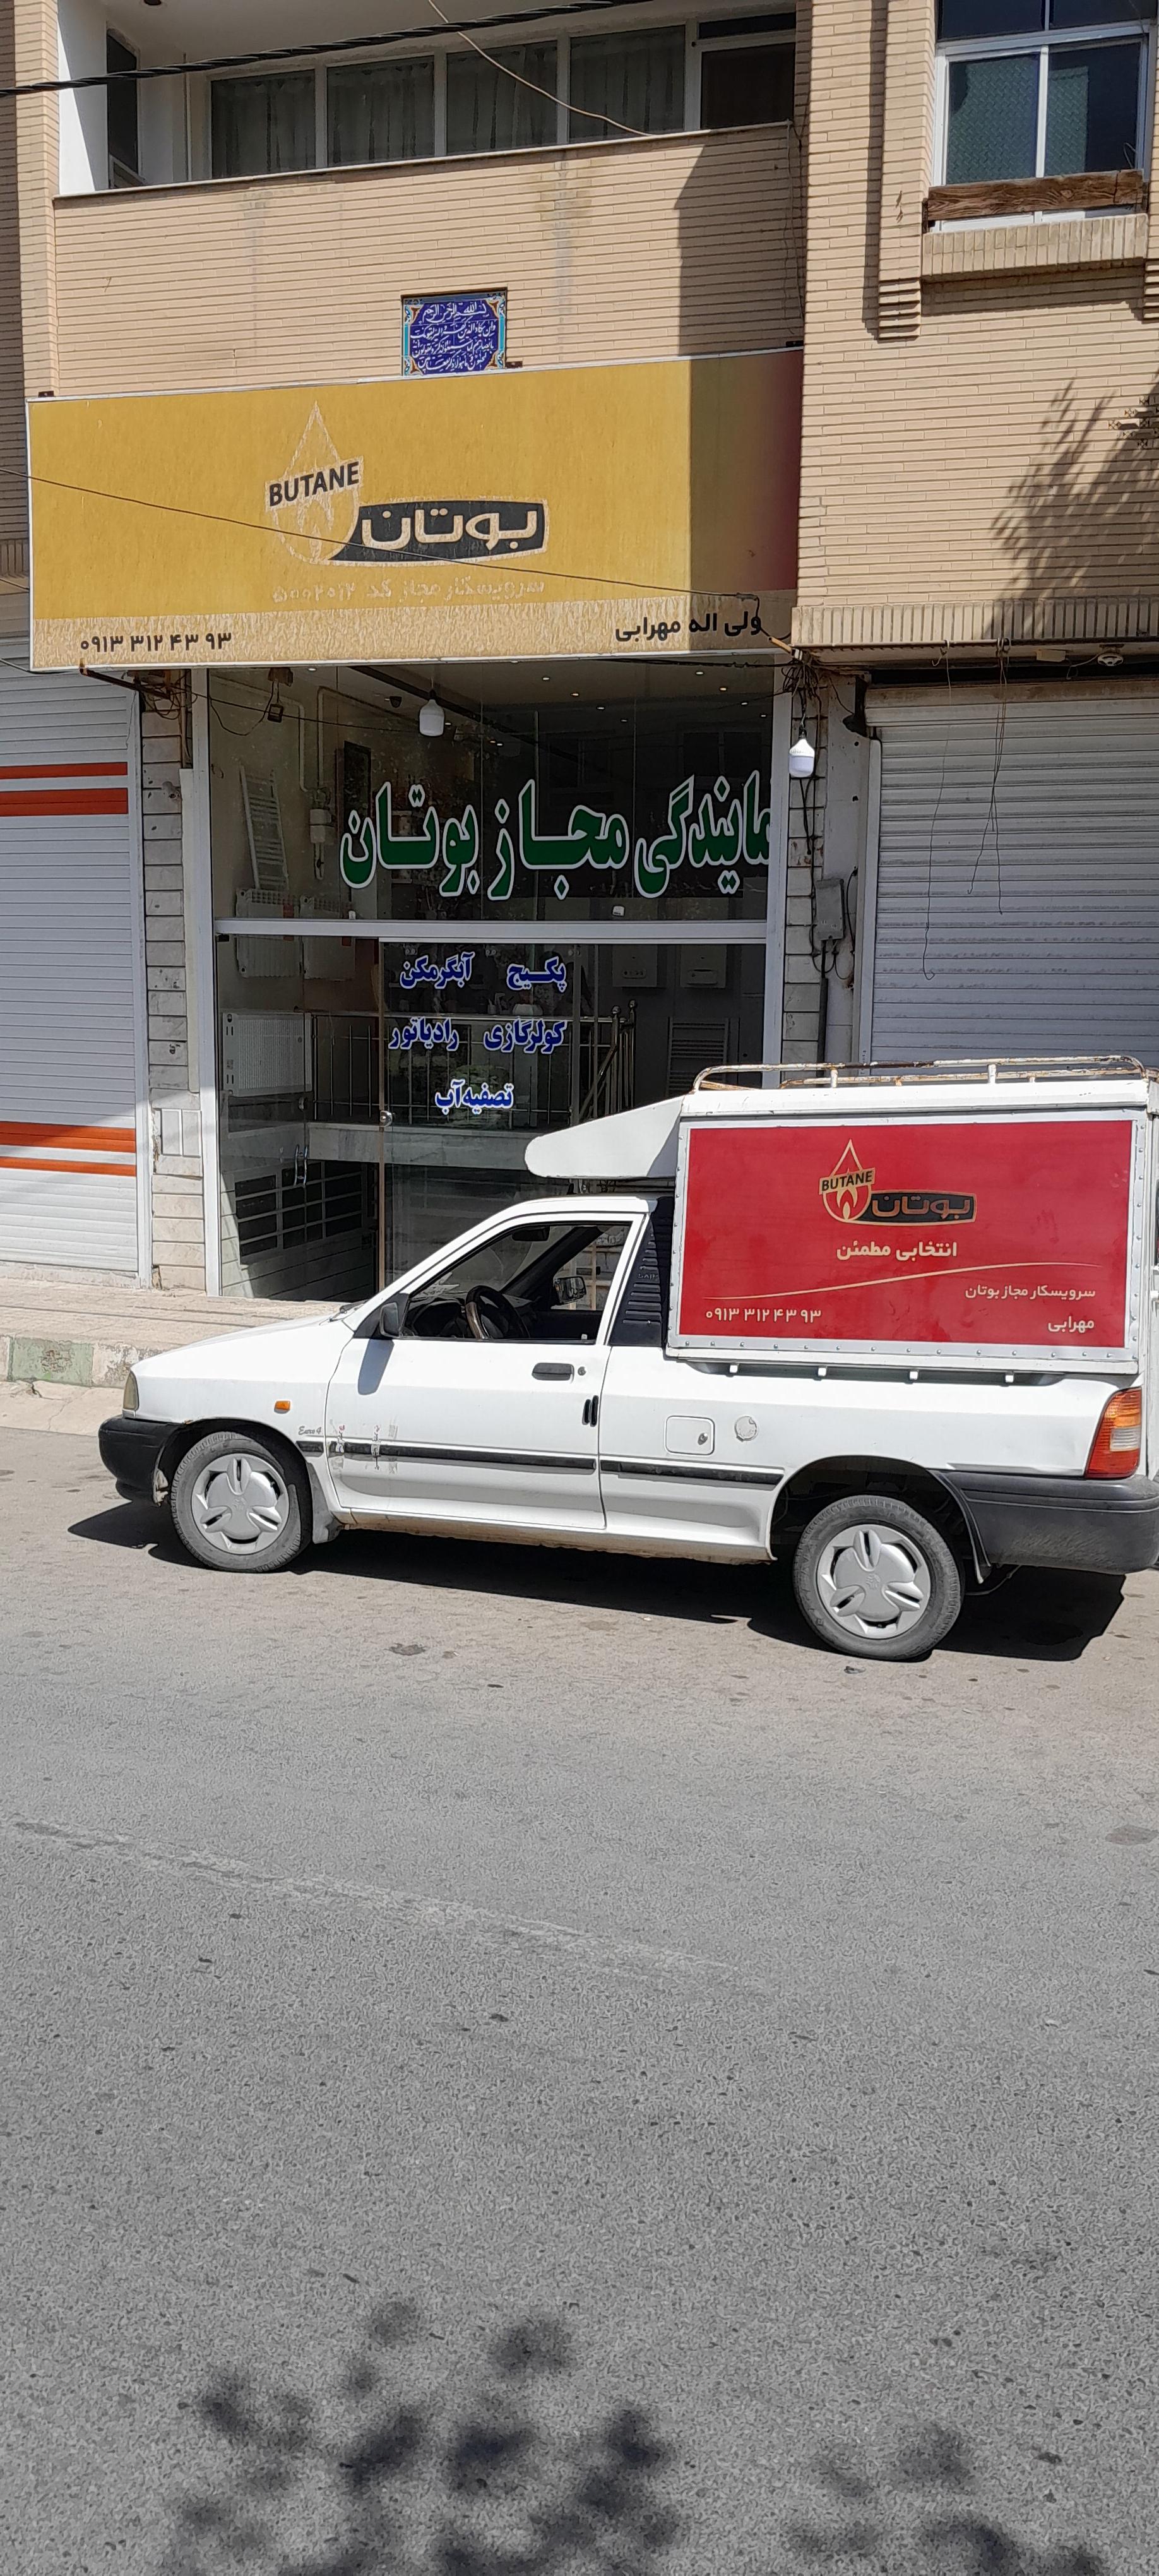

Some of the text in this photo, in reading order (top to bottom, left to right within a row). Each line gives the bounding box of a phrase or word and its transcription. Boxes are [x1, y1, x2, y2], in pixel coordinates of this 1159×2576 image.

[269, 461, 359, 506] BUTANE
[362, 508, 537, 551] بوتان
[615, 611, 761, 642] ولی اله مهرابی
[80, 632, 232, 652] ۰۹۱۳ ۳۱۲ ۴۳ ۹۳
[340, 770, 770, 900] مایندگی مجاز بوتان
[506, 956, 567, 993] پکیج
[388, 1017, 459, 1051] رادیاتور
[821, 1171, 873, 1191] BUTANE
[872, 1196, 970, 1219] بوتان
[836, 1240, 957, 1261] انتخابی مطمئن
[965, 1284, 1095, 1300] سرویسکار مجاز بوتان
[706, 1308, 821, 1323] ۰۹۱۳ ۳۱۲ ۴۳ ۹۳
[1048, 1316, 1095, 1333] مهرابی
